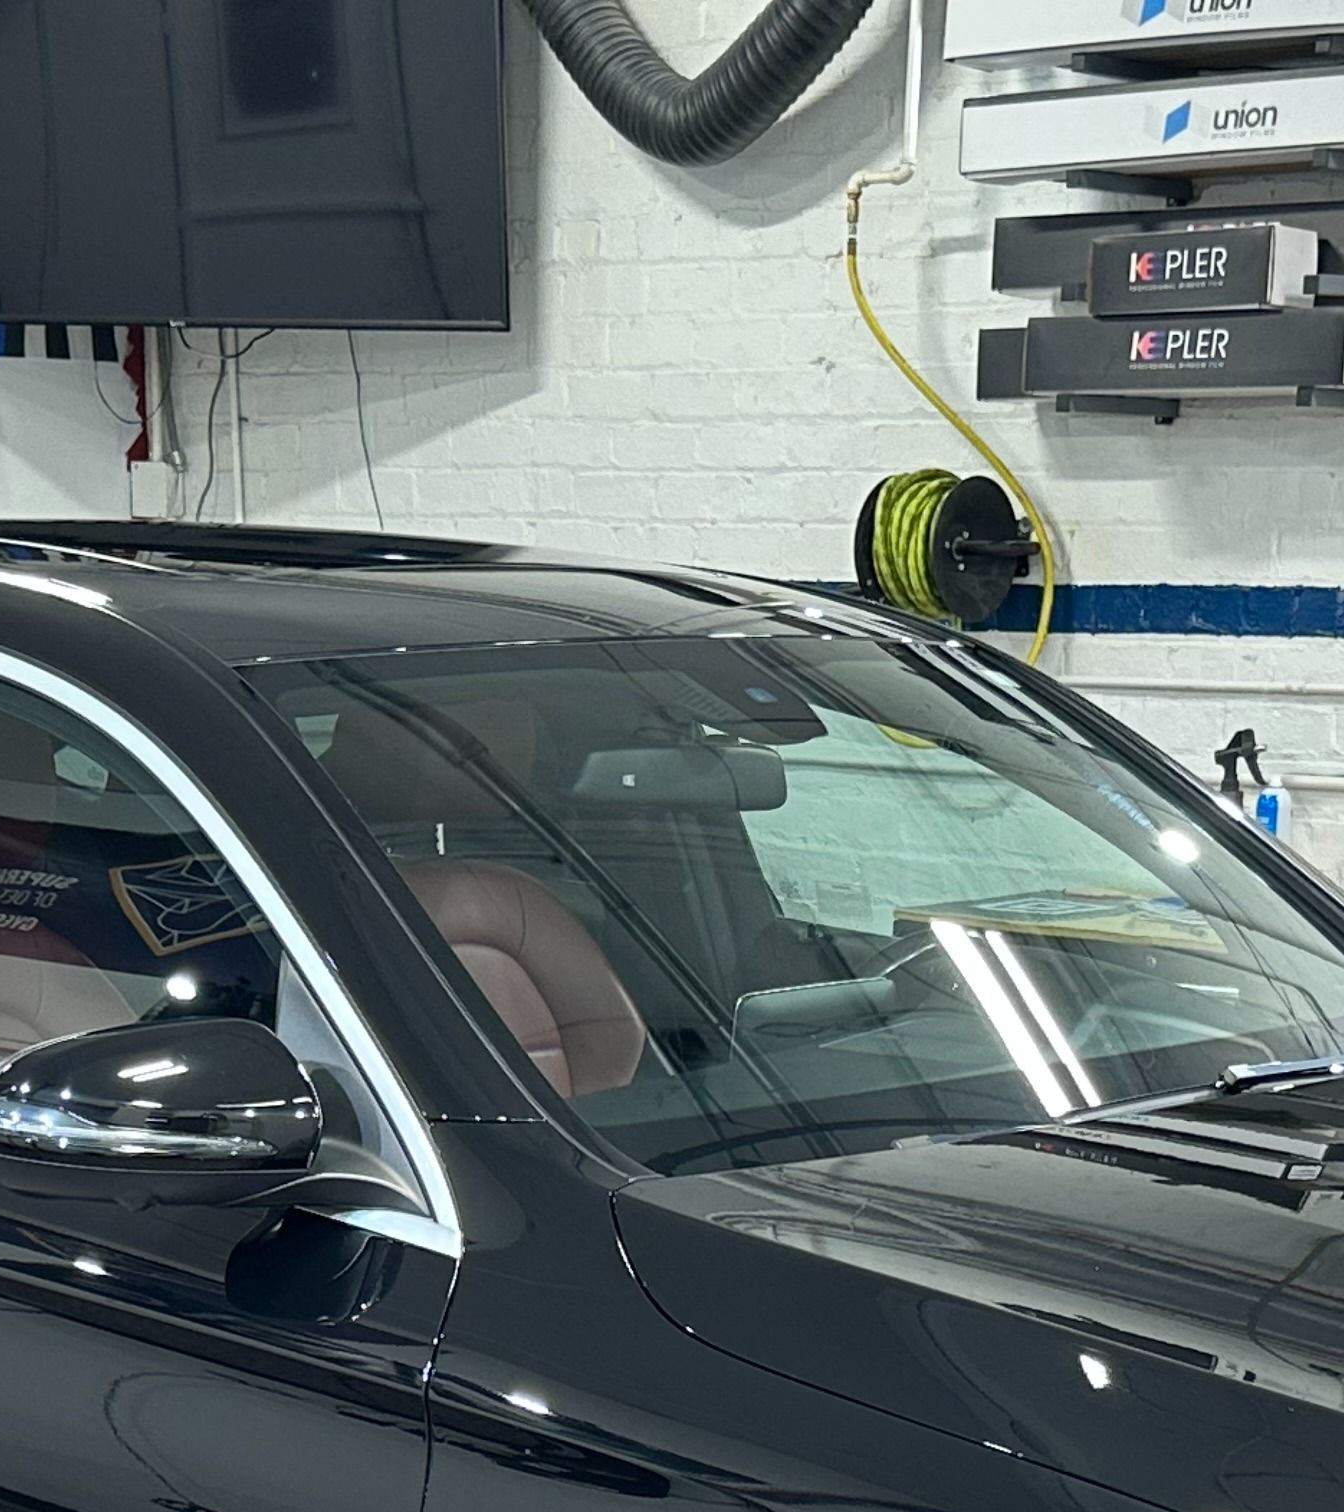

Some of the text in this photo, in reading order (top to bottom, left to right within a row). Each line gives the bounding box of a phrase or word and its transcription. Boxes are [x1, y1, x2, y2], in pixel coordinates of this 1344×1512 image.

[1213, 100, 1278, 130] union
[1128, 247, 1228, 283] KEPLER
[1129, 328, 1229, 361] KEPLER
